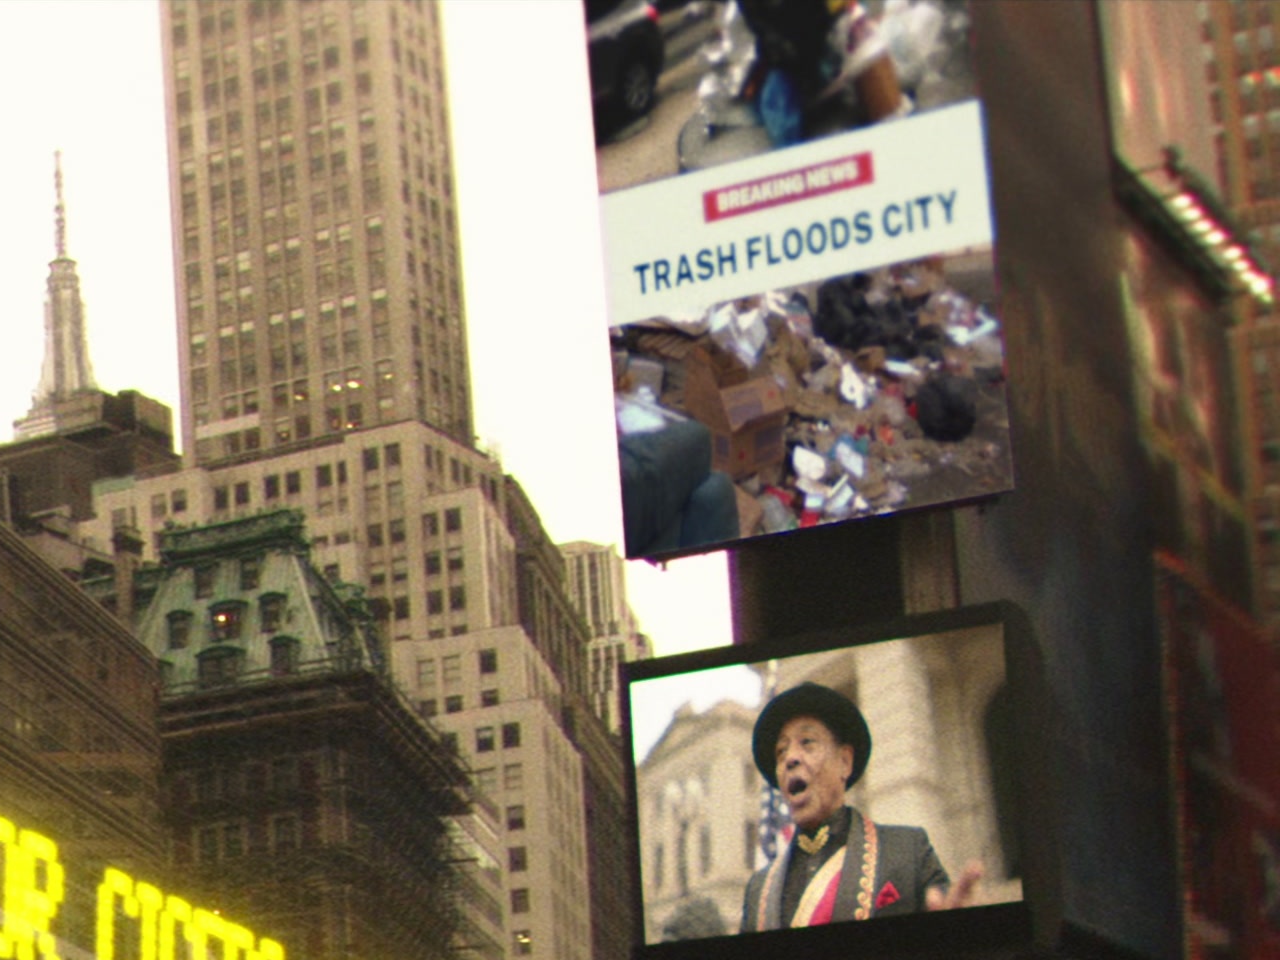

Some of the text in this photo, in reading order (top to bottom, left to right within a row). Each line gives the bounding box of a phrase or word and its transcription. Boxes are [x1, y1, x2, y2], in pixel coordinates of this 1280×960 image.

[716, 161, 860, 212] BREAKING NEWS
[634, 190, 958, 295] TRASH FLOODS CITY
